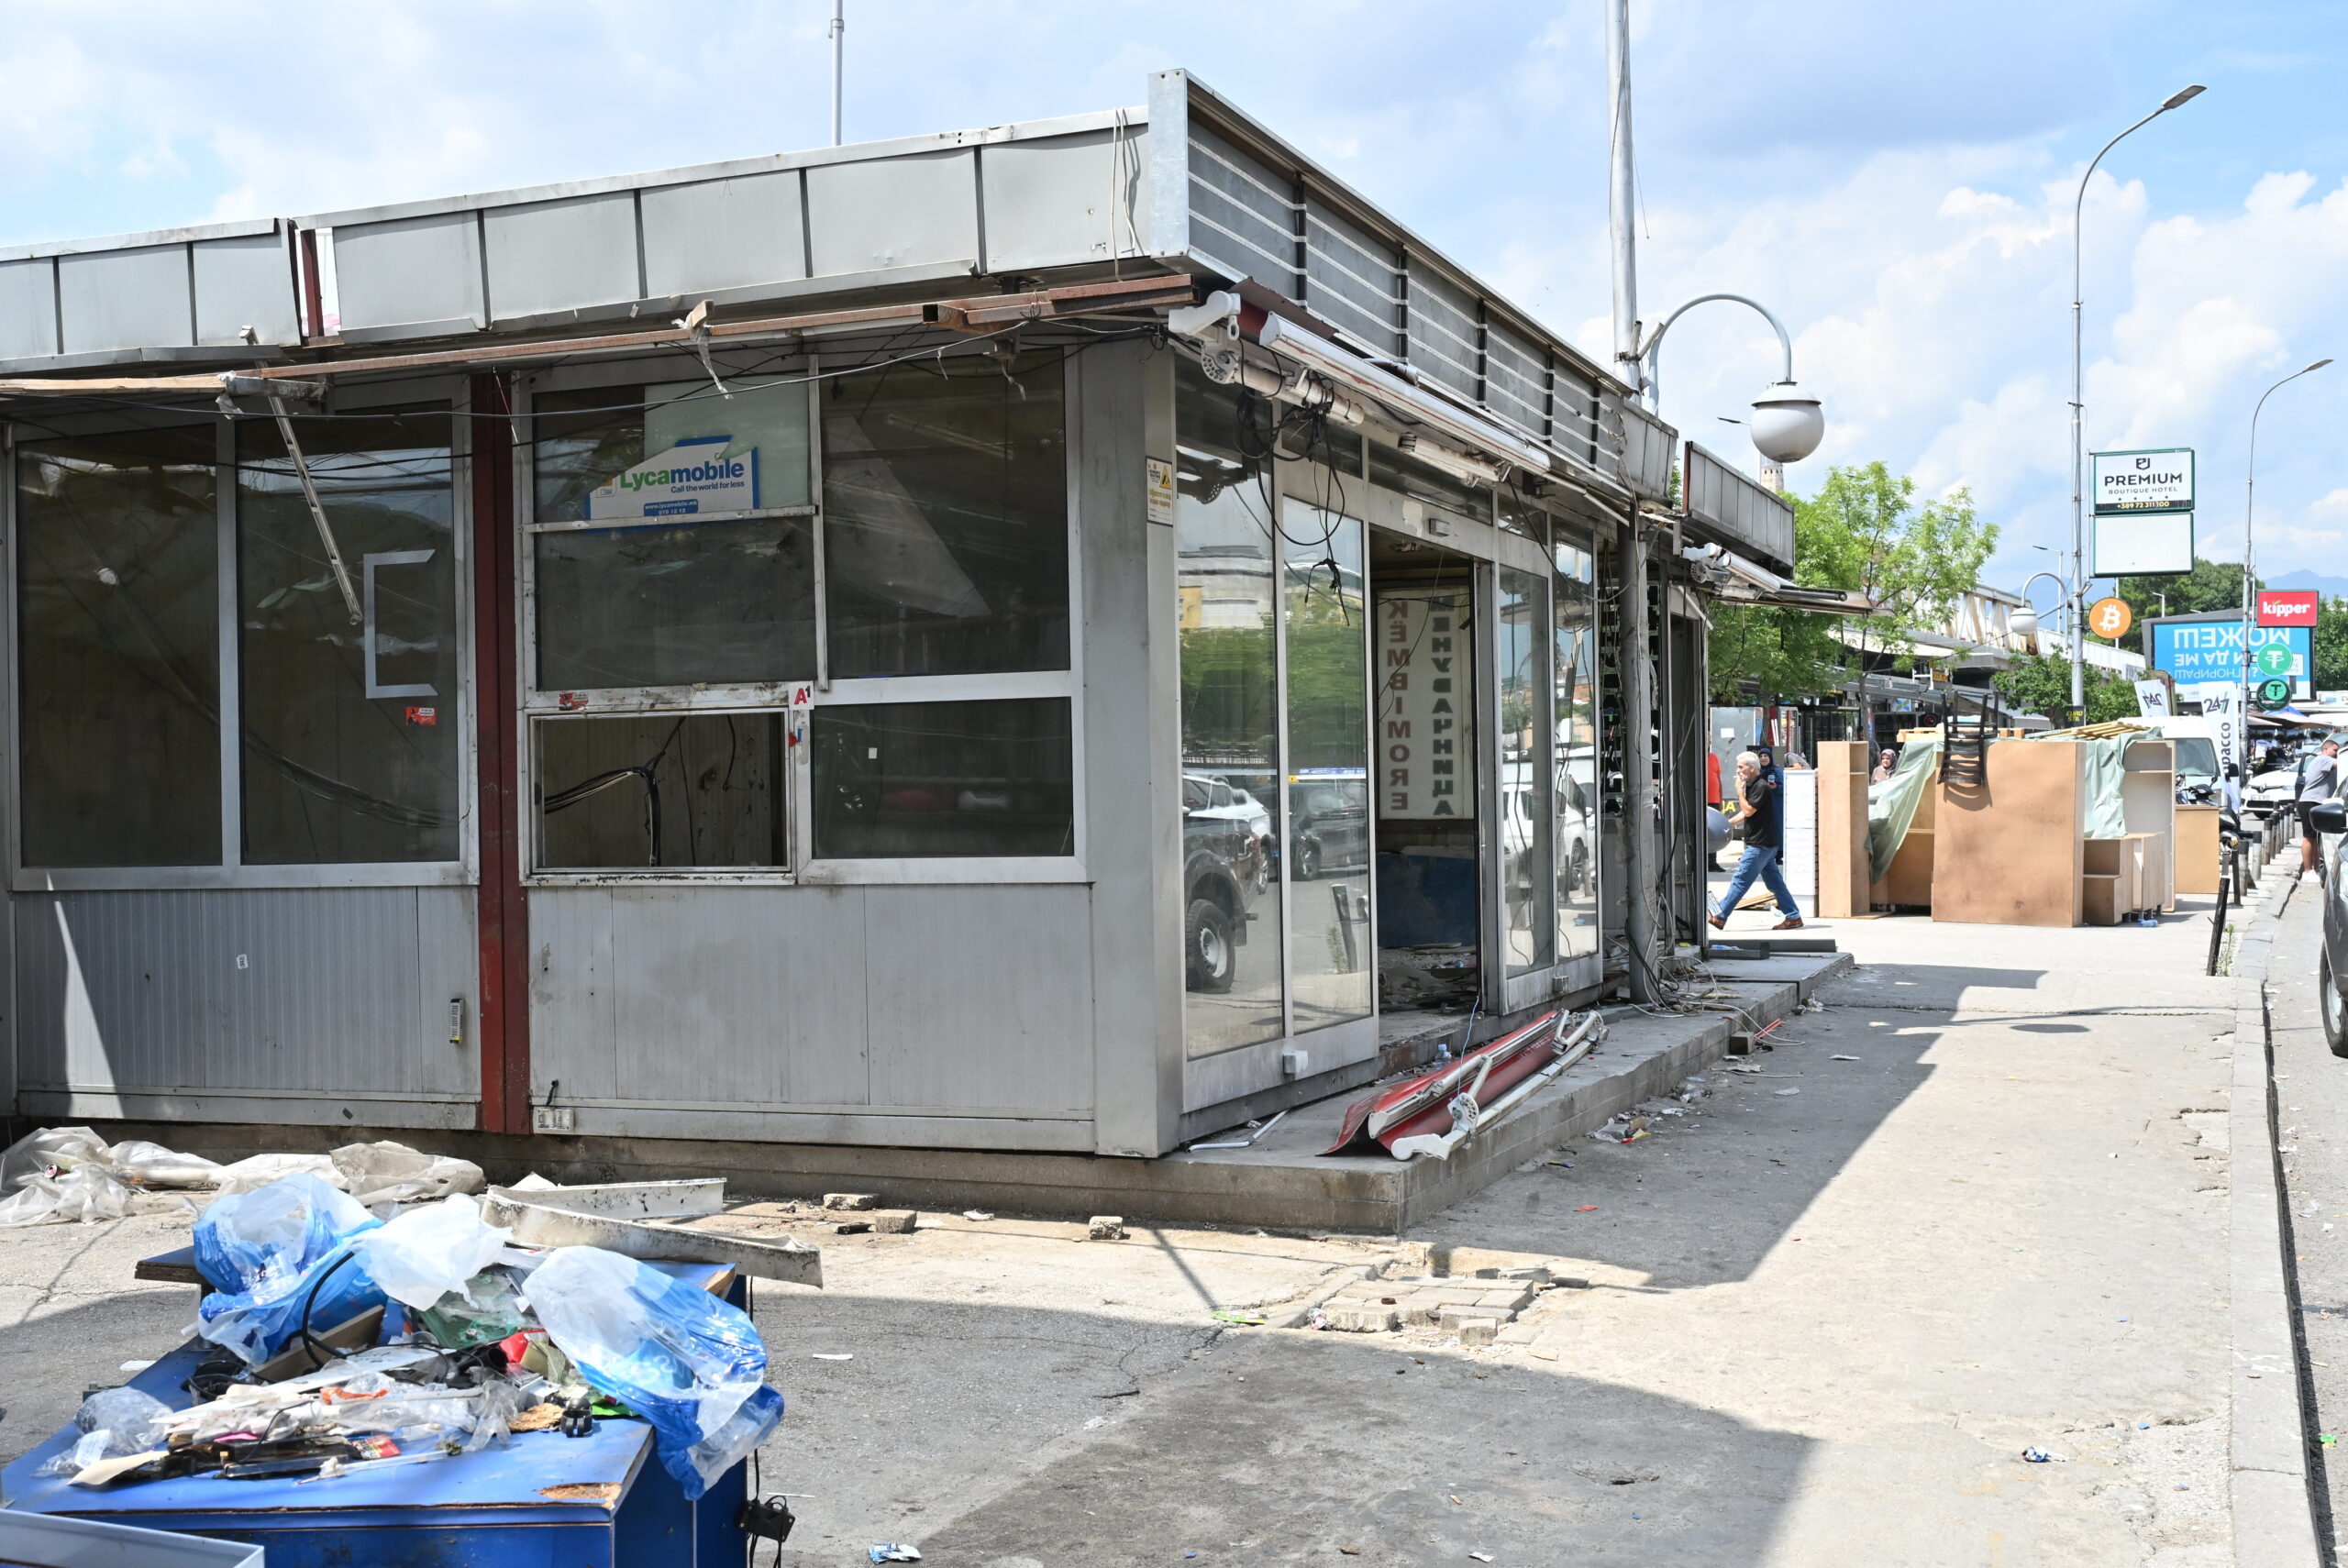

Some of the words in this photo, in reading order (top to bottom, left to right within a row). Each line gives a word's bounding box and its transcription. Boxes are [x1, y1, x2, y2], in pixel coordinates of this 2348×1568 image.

[620, 459, 745, 491] Lycamobile
[2104, 472, 2182, 487] PREMIUM
[670, 485, 685, 493] Call
[686, 484, 698, 492] the
[698, 482, 718, 491] world
[719, 481, 730, 490] for
[730, 480, 745, 489] less
[2108, 487, 2149, 495] BOUTIQUE
[2263, 601, 2310, 617] kipper
[2175, 653, 2198, 667] МЕ
[2204, 650, 2230, 666] ДА
[2175, 668, 2250, 679] ГНОРИРАШ
